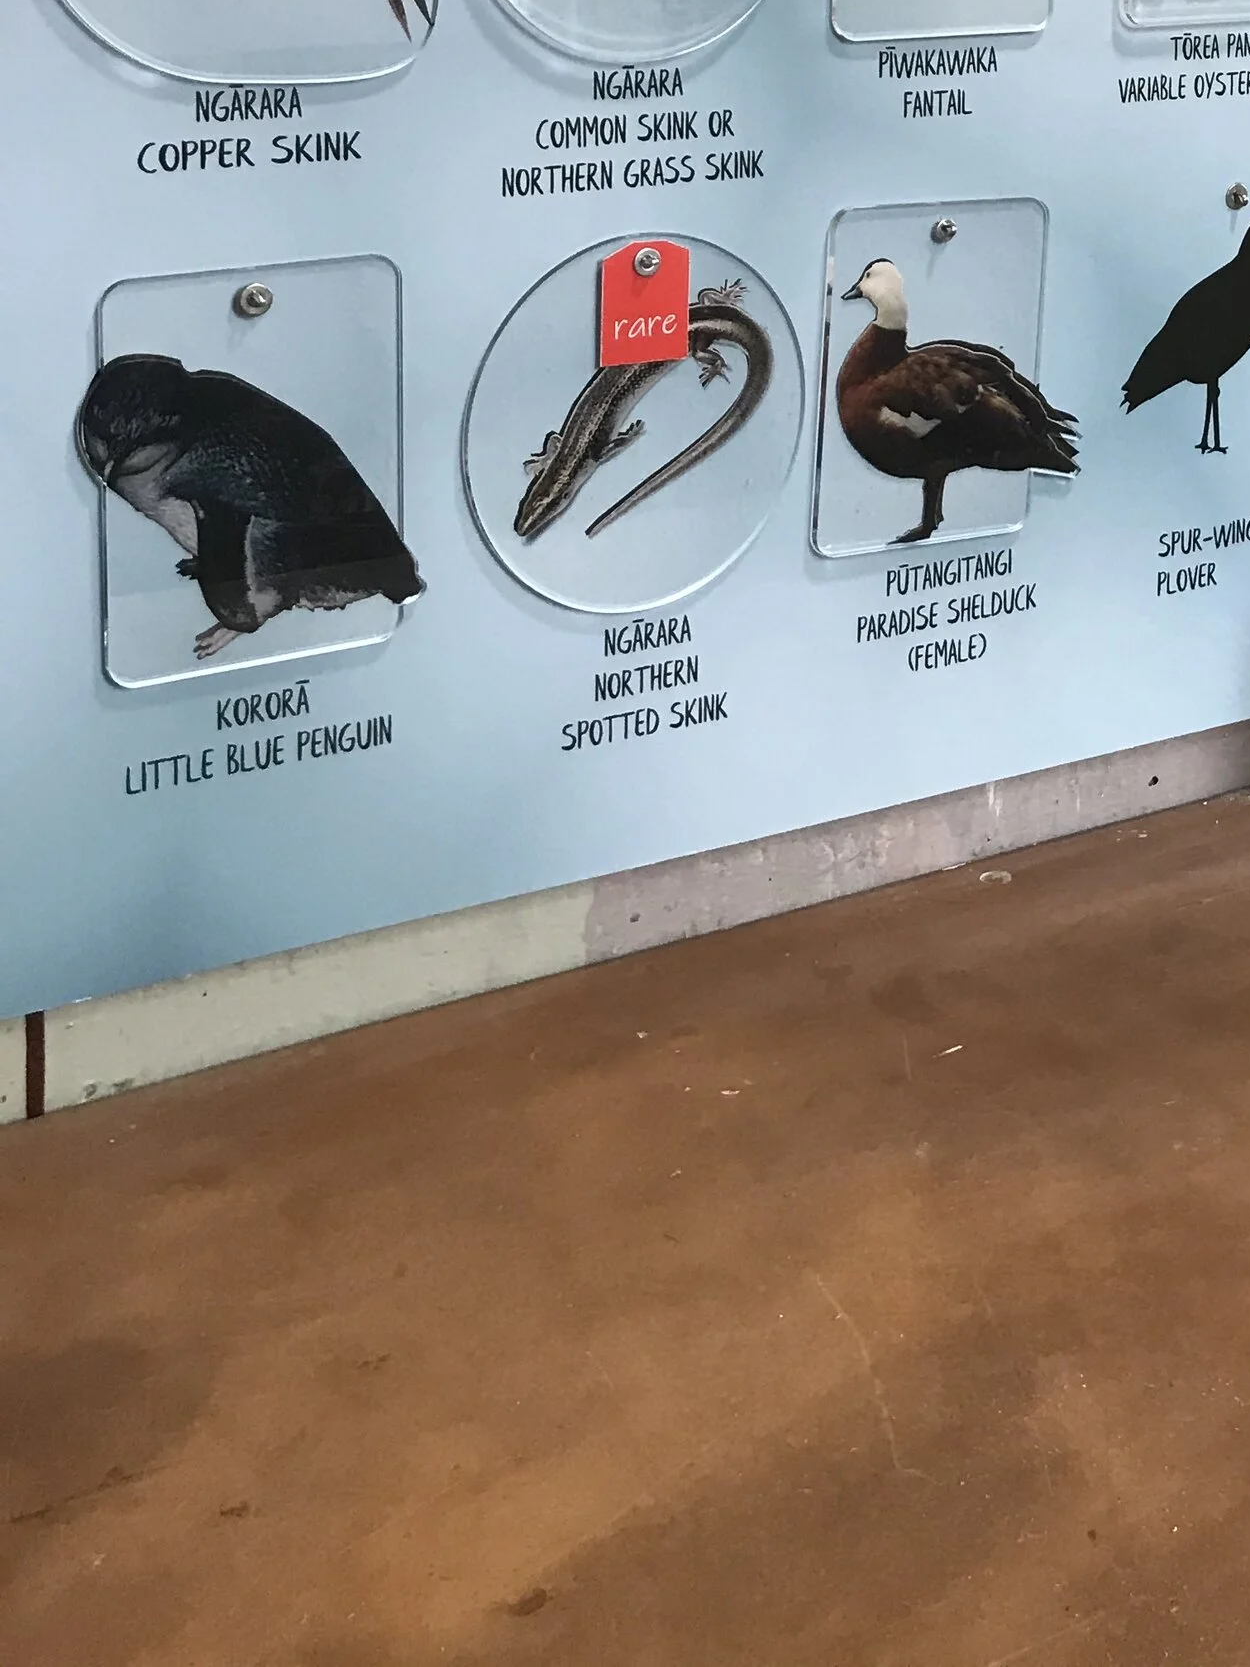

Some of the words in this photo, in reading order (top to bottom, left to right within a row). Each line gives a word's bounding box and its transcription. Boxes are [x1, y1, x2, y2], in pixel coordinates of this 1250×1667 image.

[878, 44, 998, 79] PĪWAKAWAKA
[1170, 32, 1220, 61] TŌREA
[195, 83, 303, 123] NGĀRARA
[593, 65, 684, 101] NGĀRARA
[903, 88, 973, 119] FANTAIL
[1118, 73, 1187, 104] VARIABLE
[535, 114, 627, 150] COMMON
[636, 110, 699, 143] SKINK
[708, 109, 735, 138] OR
[137, 138, 255, 174] COPPER
[271, 130, 362, 165] SKINK
[502, 160, 614, 198] NORTHERN
[623, 154, 696, 189] GRASS
[704, 150, 765, 181] SKINK
[613, 313, 678, 340] rare
[886, 548, 1013, 598] PŪTANGITANGI
[1156, 562, 1218, 597] PLOVER
[857, 601, 938, 643] PARADISE
[947, 583, 1038, 626] SHELDUCK
[604, 614, 692, 657] NGĀRARA
[908, 632, 987, 672] (FEMALE)
[594, 655, 699, 702] NORTHERN
[217, 679, 311, 730] KORORĀ
[561, 707, 660, 751] SPOTTED
[669, 692, 728, 729] SKINK
[126, 748, 214, 796] LITTLE
[227, 735, 285, 775] BLUE
[297, 714, 393, 761] PENGUIN
